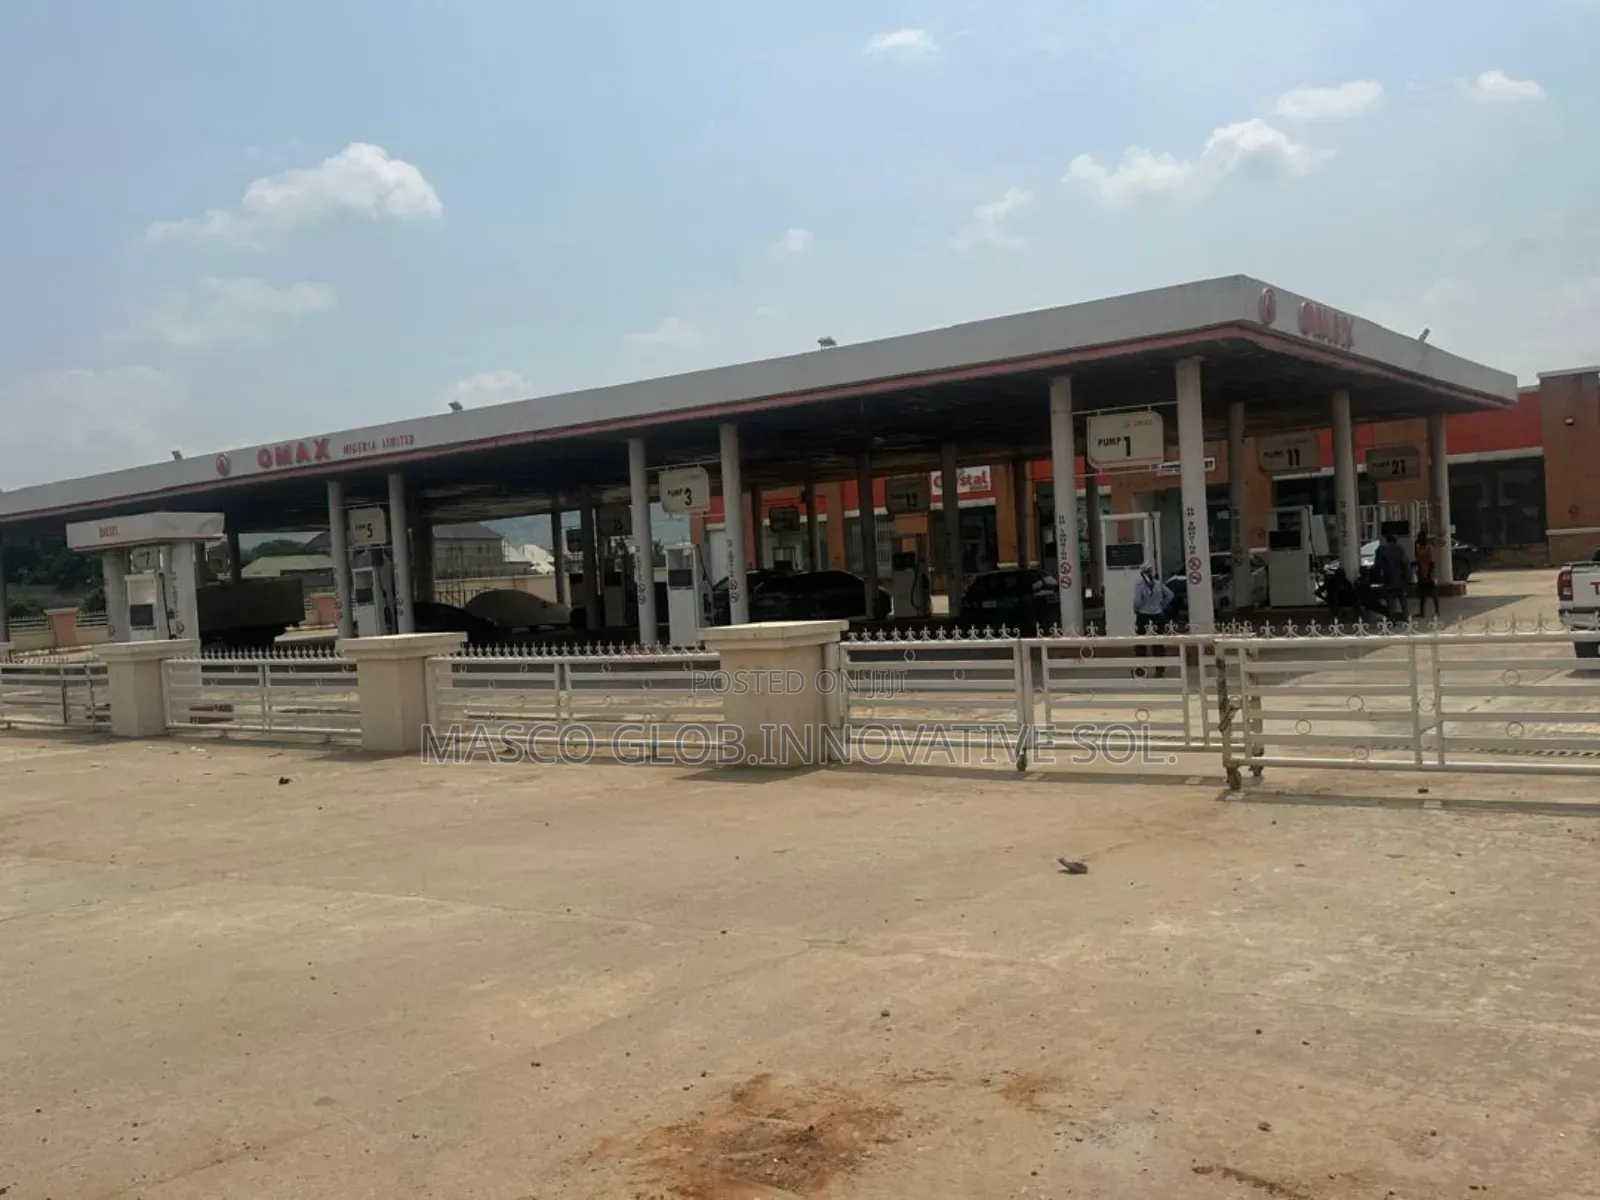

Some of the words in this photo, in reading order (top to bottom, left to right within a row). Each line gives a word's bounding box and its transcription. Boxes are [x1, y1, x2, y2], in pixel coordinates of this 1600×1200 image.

[256, 438, 332, 469] OMAX
[342, 441, 377, 457] NIGERIA
[381, 434, 415, 450] LIMITED
[1097, 437, 1122, 449] PUMP
[1123, 435, 1132, 457] 1
[1286, 447, 1300, 466] 11
[1391, 459, 1406, 475] 21
[684, 487, 693, 506] 3
[99, 524, 119, 539] DIESEL
[367, 522, 373, 539] 5
